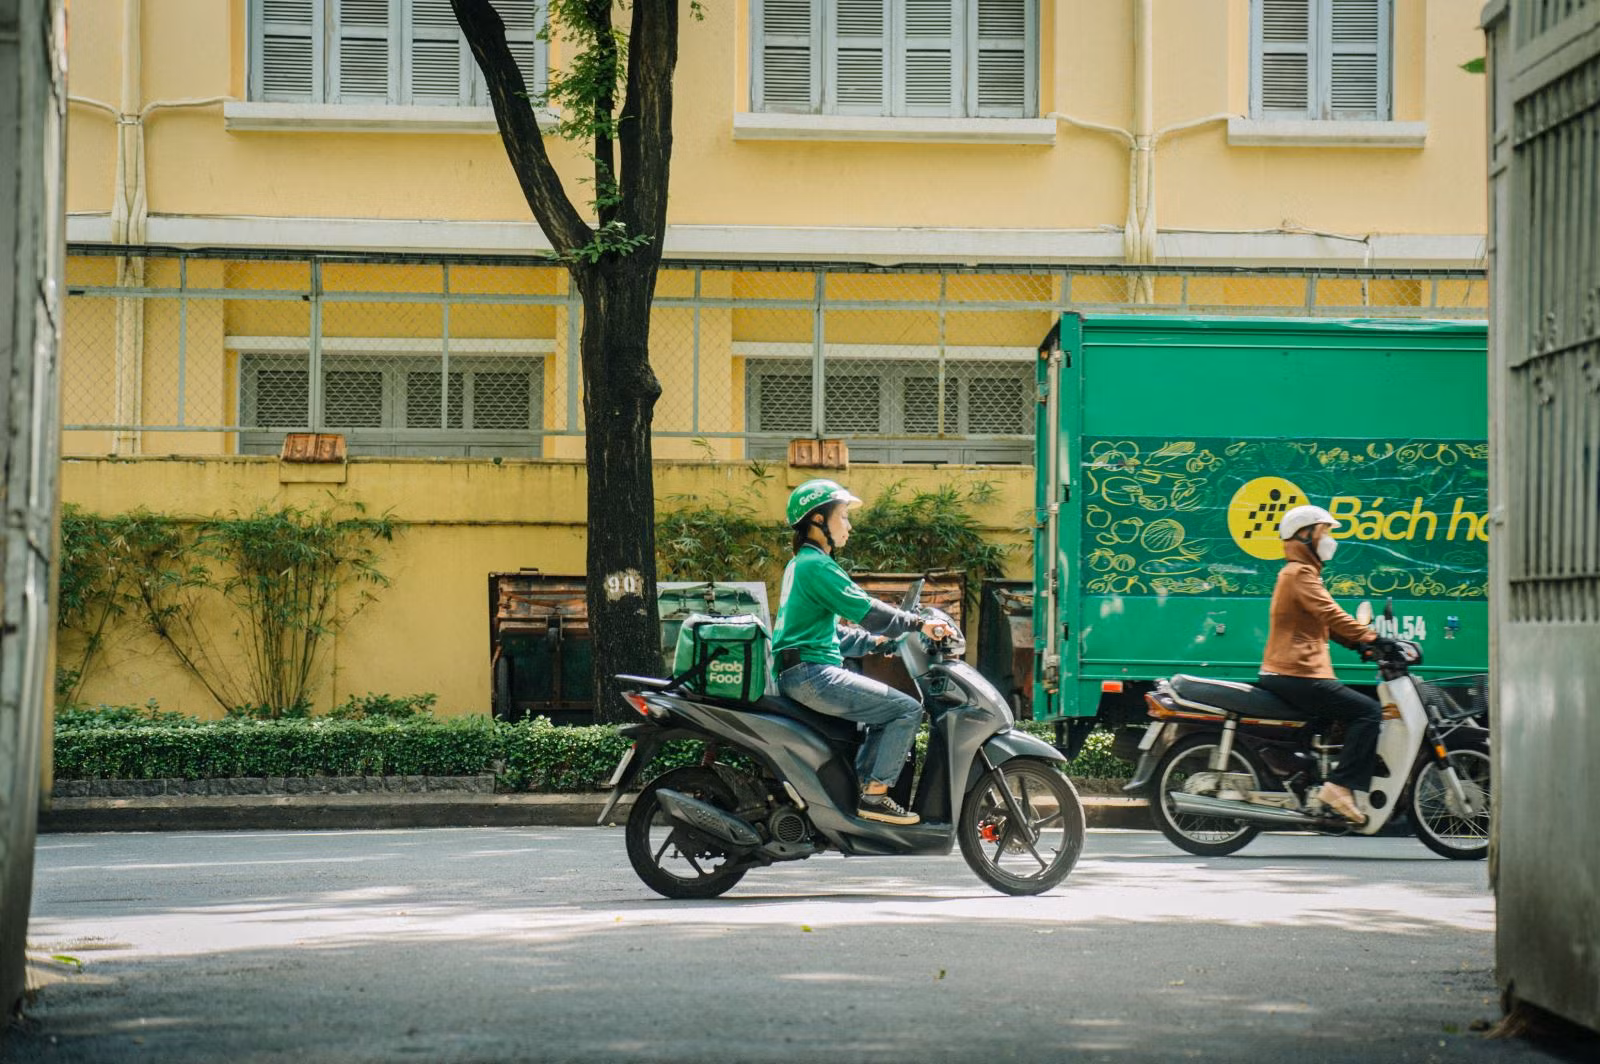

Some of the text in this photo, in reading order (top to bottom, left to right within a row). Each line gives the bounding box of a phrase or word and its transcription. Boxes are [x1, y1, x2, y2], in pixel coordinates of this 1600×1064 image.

[799, 489, 825, 506] Grab
[1328, 496, 1438, 541] Bách
[608, 575, 635, 593] 90
[710, 660, 743, 672] Grab
[710, 672, 743, 684] Food
